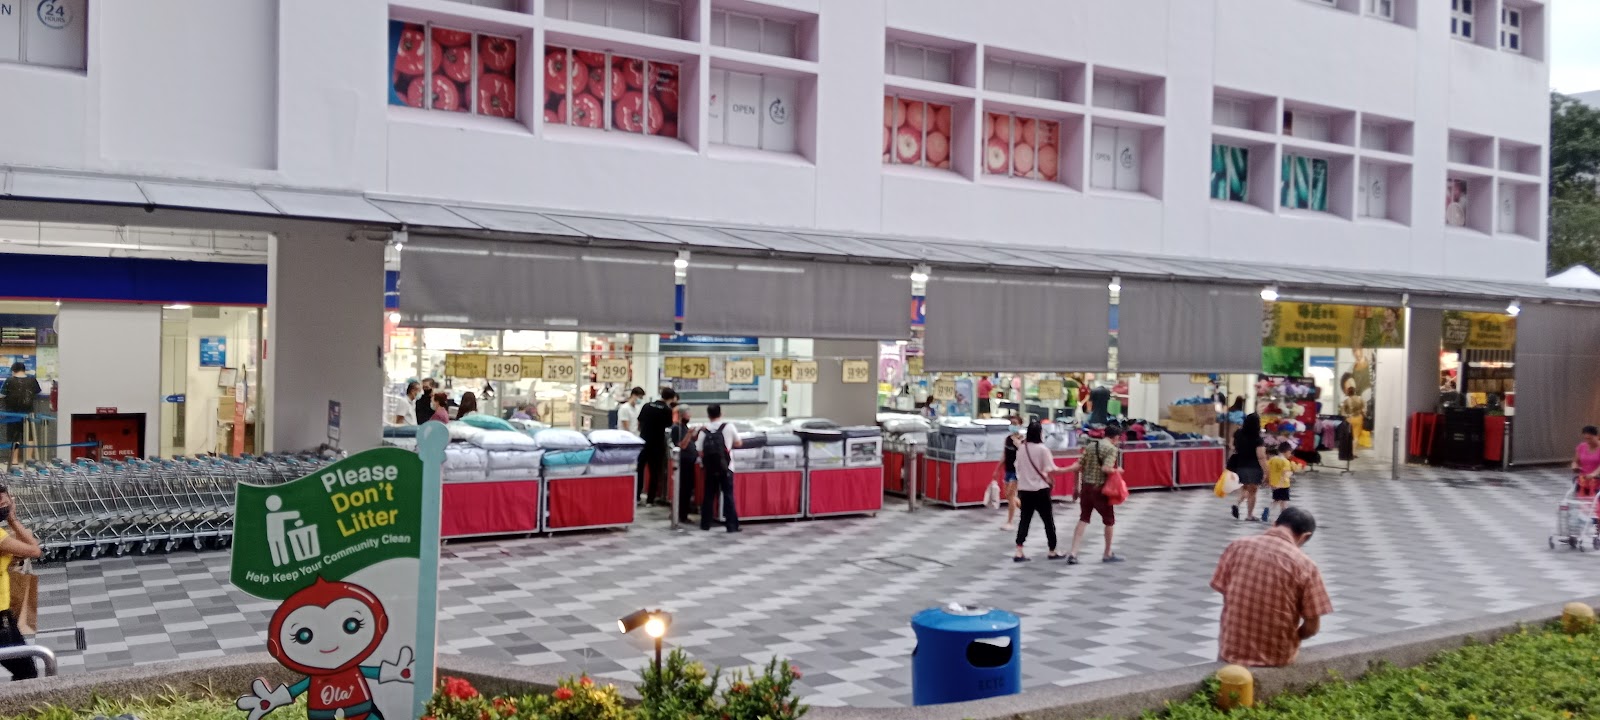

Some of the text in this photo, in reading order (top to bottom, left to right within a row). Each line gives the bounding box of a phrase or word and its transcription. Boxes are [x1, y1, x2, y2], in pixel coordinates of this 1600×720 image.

[45, 4, 65, 17] 24
[732, 103, 755, 115] OPEN
[773, 105, 785, 115] 24
[321, 465, 398, 493] Please
[331, 482, 394, 513] Don't
[337, 509, 398, 537] Litter
[246, 534, 411, 585] Help Keep Your Community Clean
